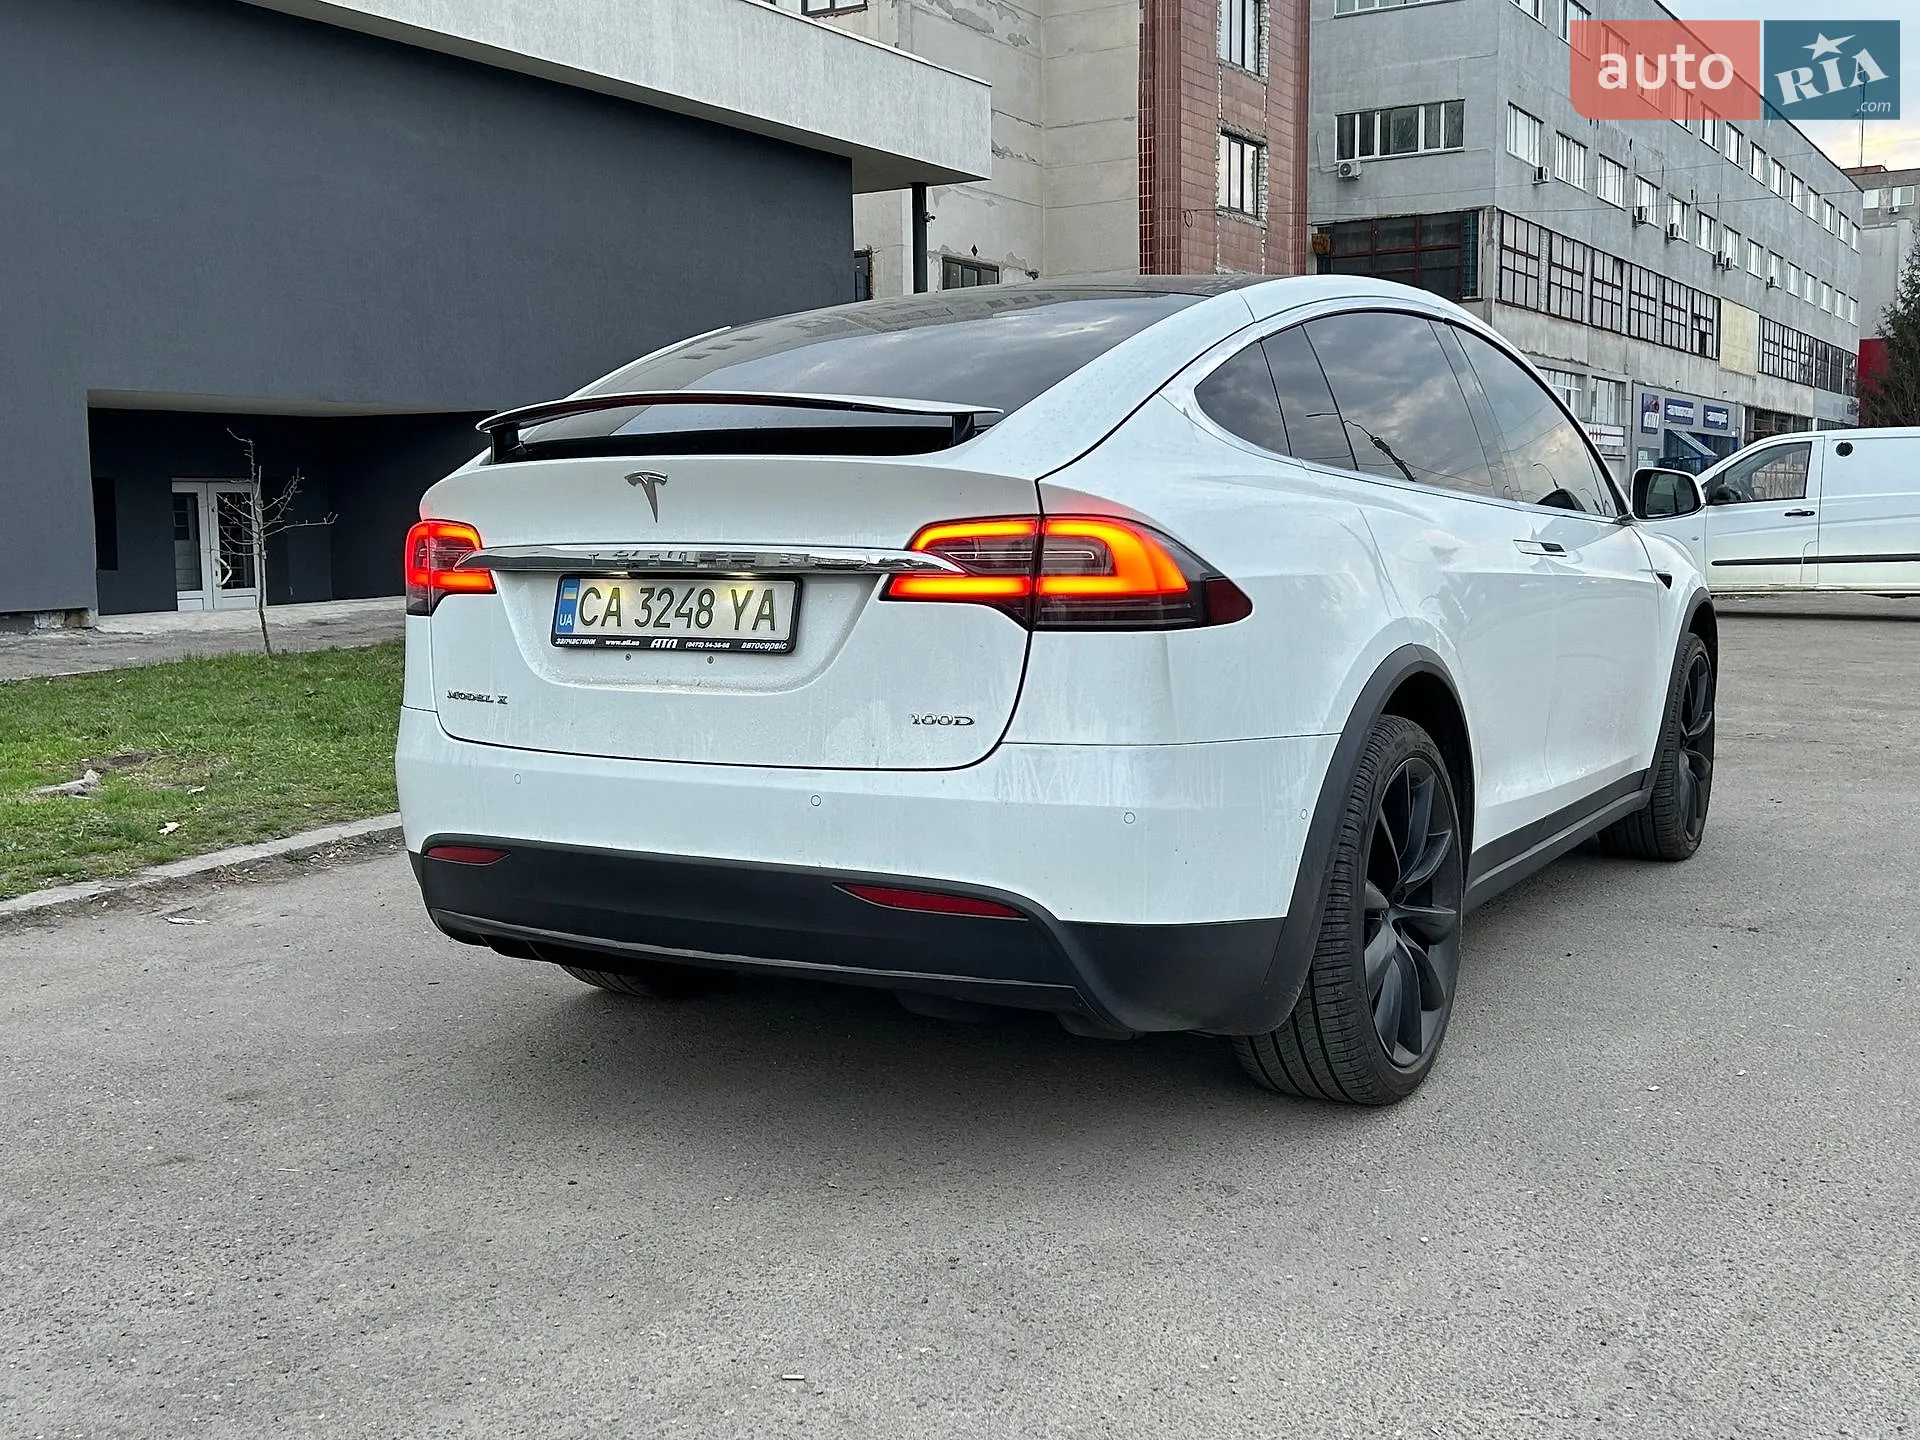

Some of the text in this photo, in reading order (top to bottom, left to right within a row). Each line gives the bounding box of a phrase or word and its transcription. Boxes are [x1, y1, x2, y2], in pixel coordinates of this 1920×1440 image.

[579, 587, 776, 632] CA 3248 YA
[559, 614, 573, 626] UA
[446, 690, 508, 705] MODEL X
[911, 713, 976, 726] 100D
